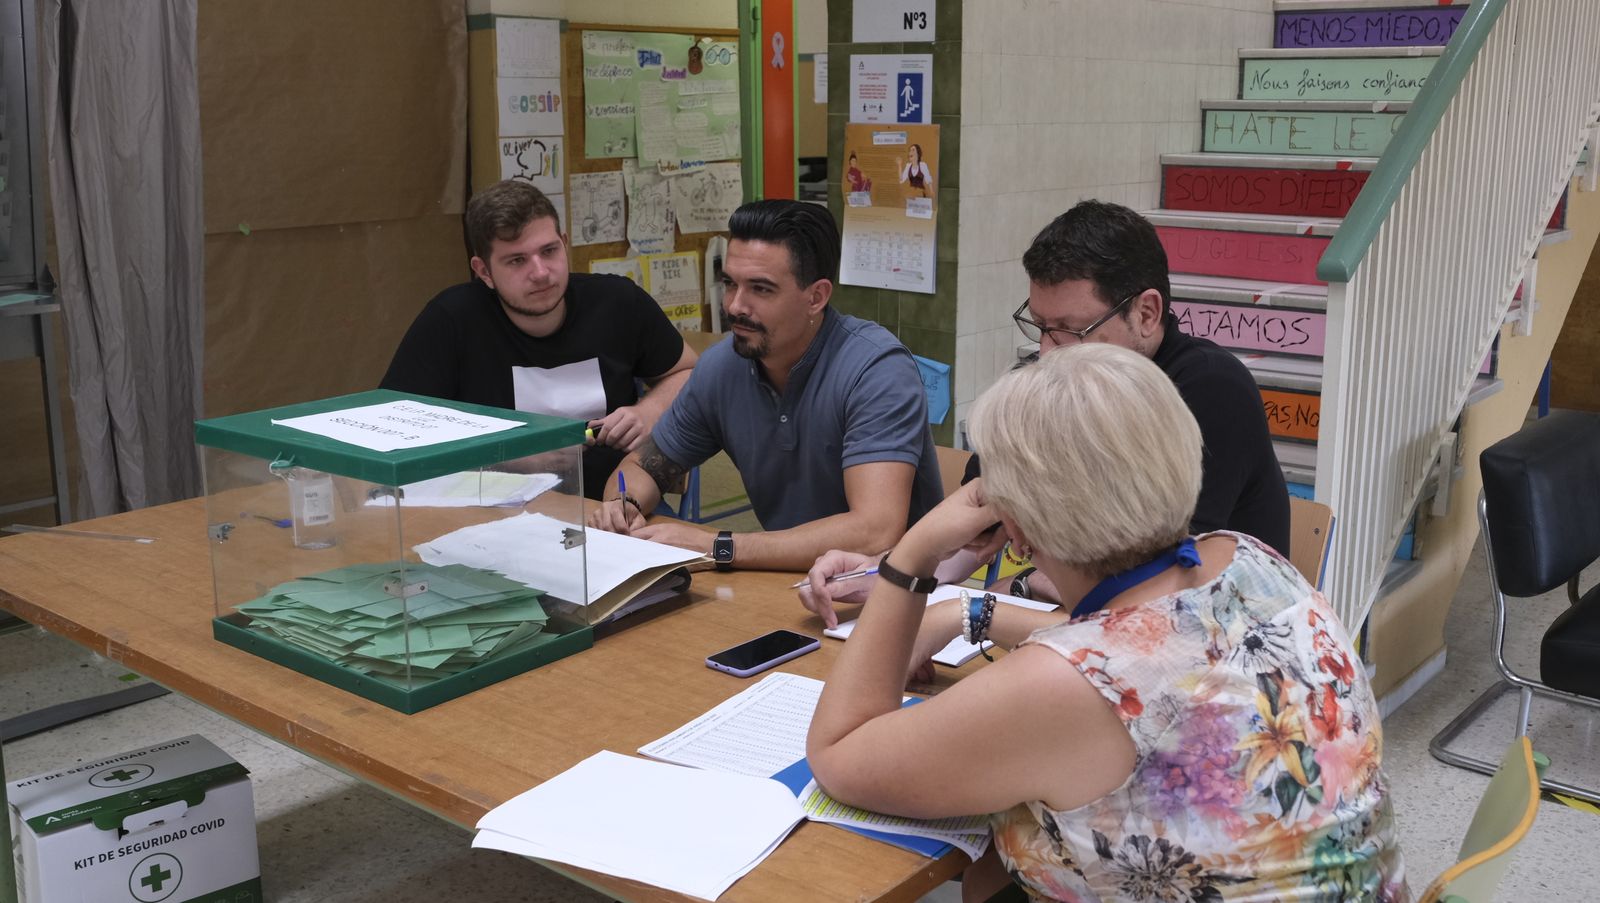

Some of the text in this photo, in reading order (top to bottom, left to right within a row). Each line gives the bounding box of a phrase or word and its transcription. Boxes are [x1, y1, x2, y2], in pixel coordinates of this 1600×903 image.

[903, 11, 927, 30] Nº3
[1280, 15, 1358, 45] MENOS
[1250, 68, 1289, 91] Nous
[1298, 67, 1350, 96] faisons
[1212, 112, 1315, 150] HATE
[1174, 172, 1271, 207] SOMOS
[16, 740, 191, 788] KIT DE SEGURIDAD COVID
[74, 817, 225, 871] KIT DE SEGURIDAD COVID
